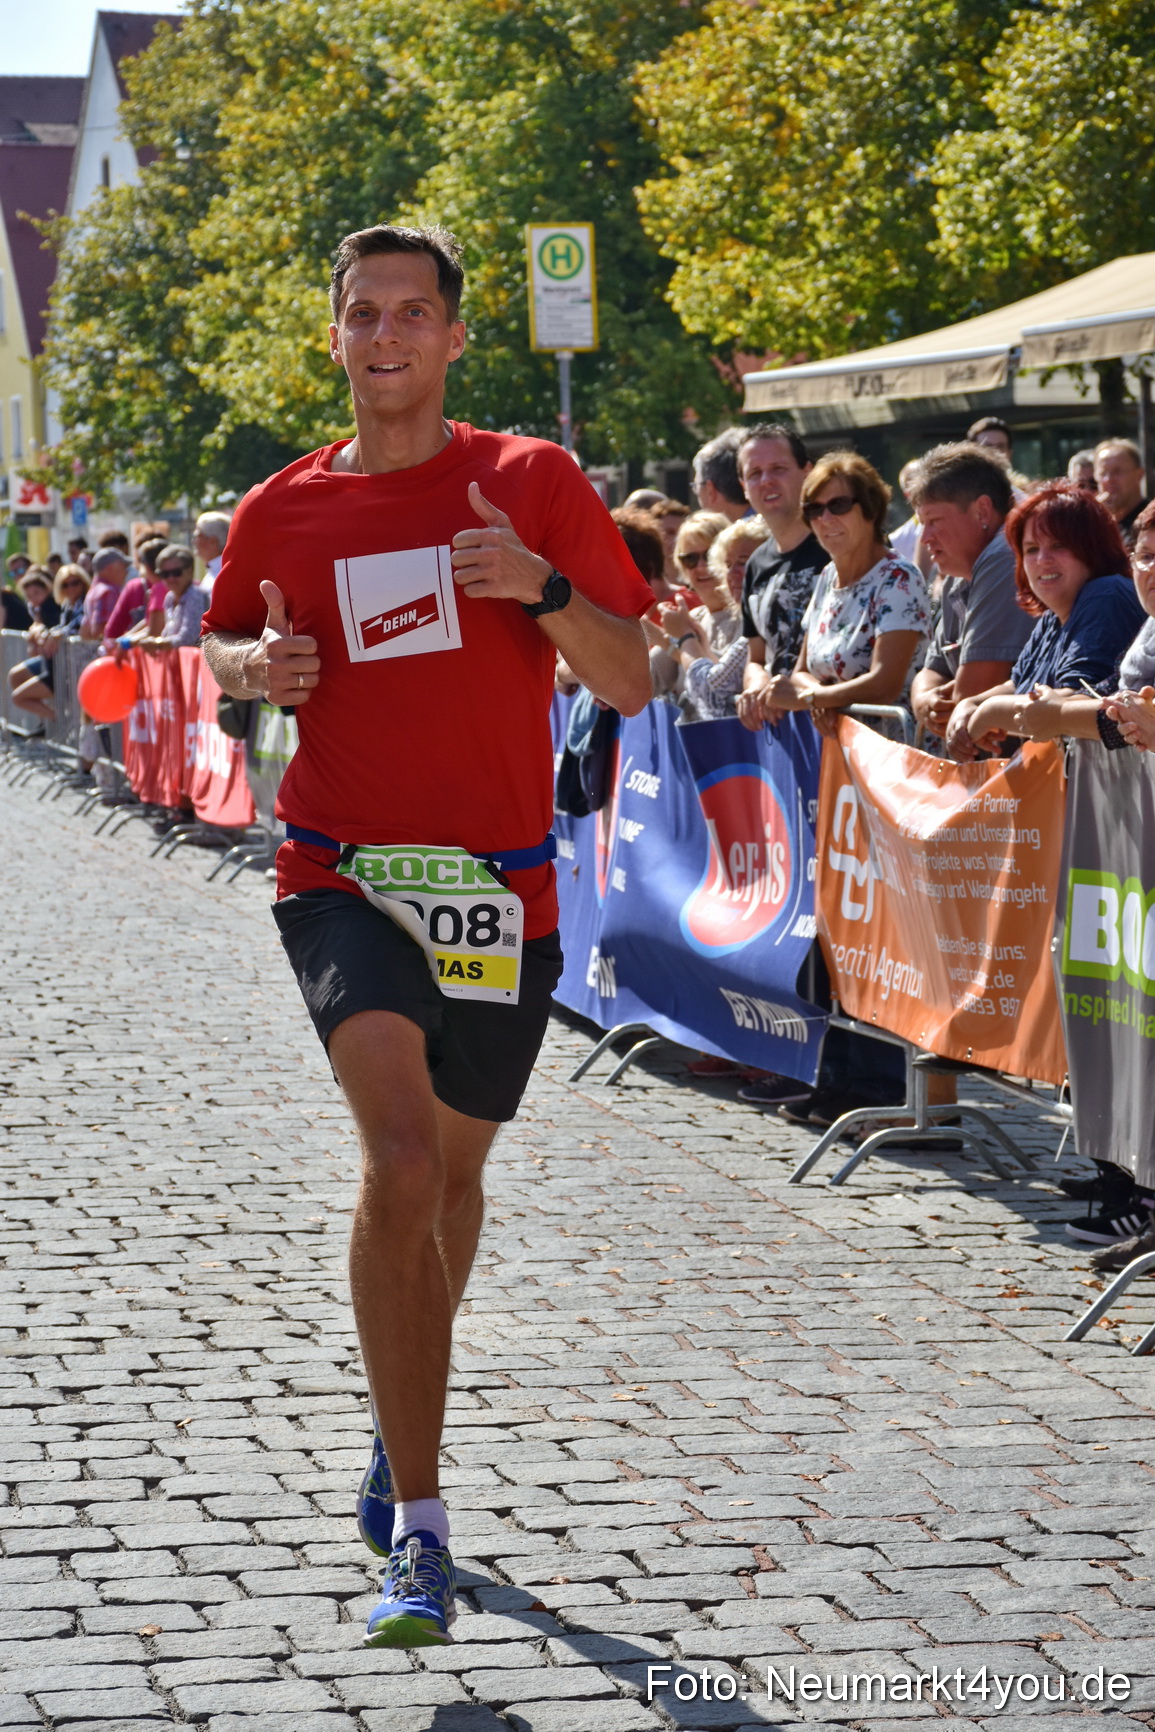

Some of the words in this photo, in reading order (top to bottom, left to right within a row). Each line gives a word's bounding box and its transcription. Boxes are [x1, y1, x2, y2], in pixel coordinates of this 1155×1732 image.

[550, 243, 572, 269] H
[383, 608, 418, 634] DEHN
[625, 769, 662, 799] STORE
[983, 793, 1022, 813] Partner
[960, 822, 978, 842] und
[354, 855, 498, 887] BOCK
[961, 855, 987, 871] was
[947, 879, 967, 899] und
[506, 907, 515, 917] C
[994, 945, 1027, 961] uns:
